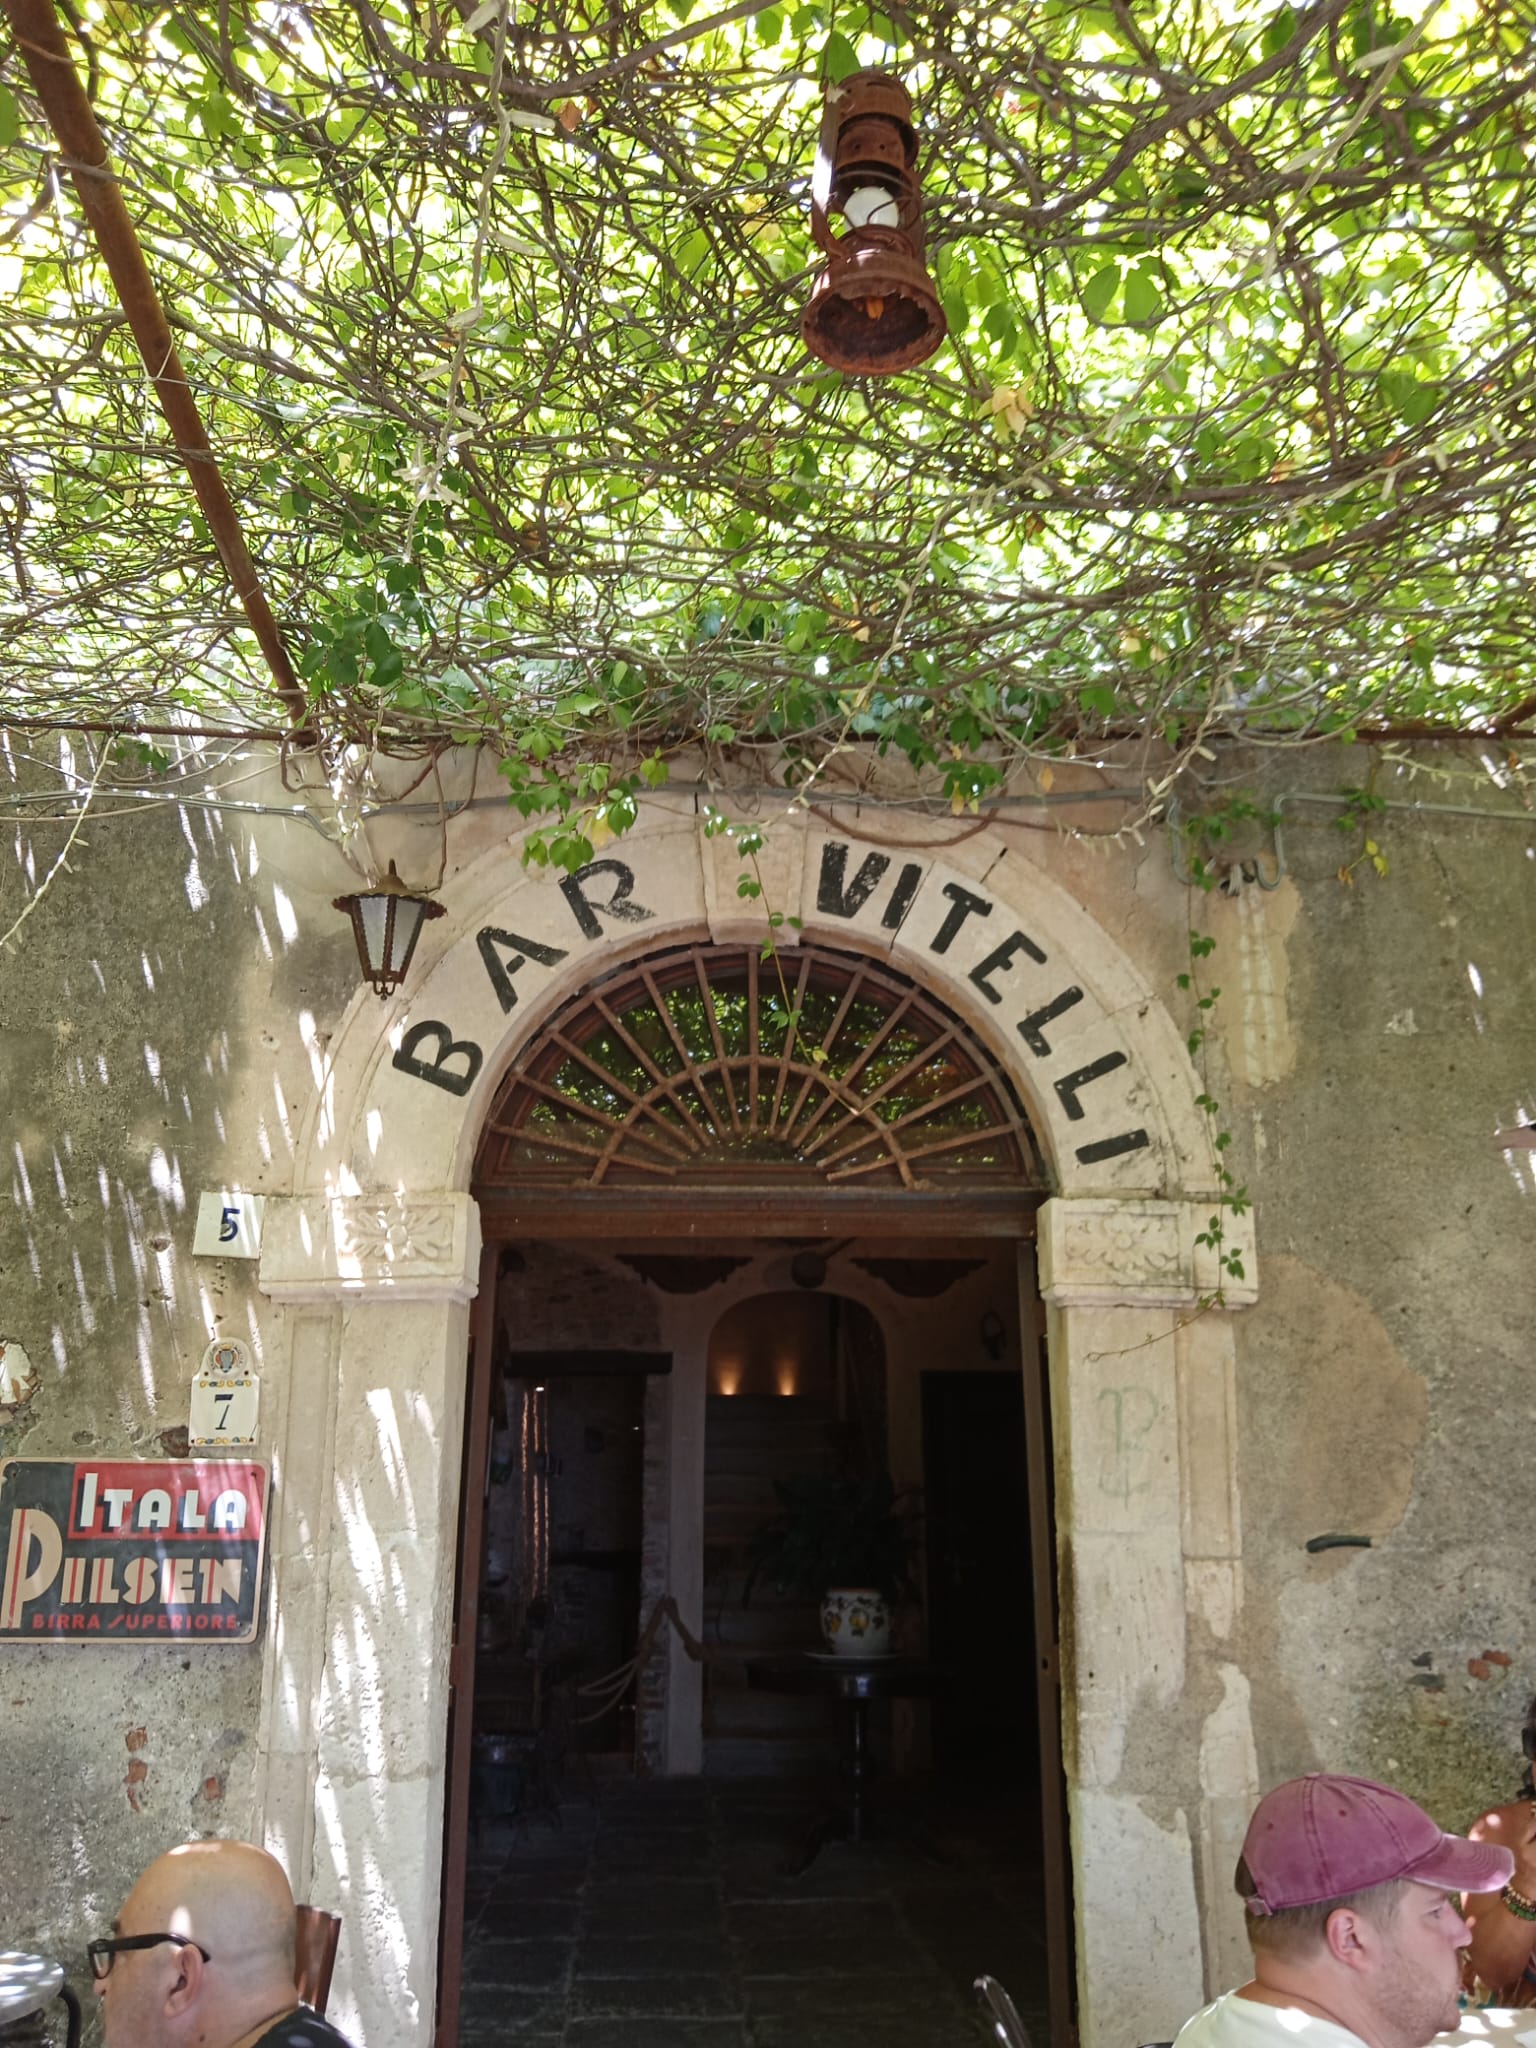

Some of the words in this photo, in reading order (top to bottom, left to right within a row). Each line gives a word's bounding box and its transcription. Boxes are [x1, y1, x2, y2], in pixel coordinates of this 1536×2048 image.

[392, 858, 658, 1098] BAR
[817, 841, 1151, 1165] VITELLI
[218, 1207, 241, 1243] 5
[214, 1393, 234, 1430] 7
[79, 1472, 247, 1529] ITALA
[0, 1508, 243, 1630] PILSEN
[32, 1613, 101, 1630] BIRRA
[107, 1612, 240, 1631] SUPERIORE
